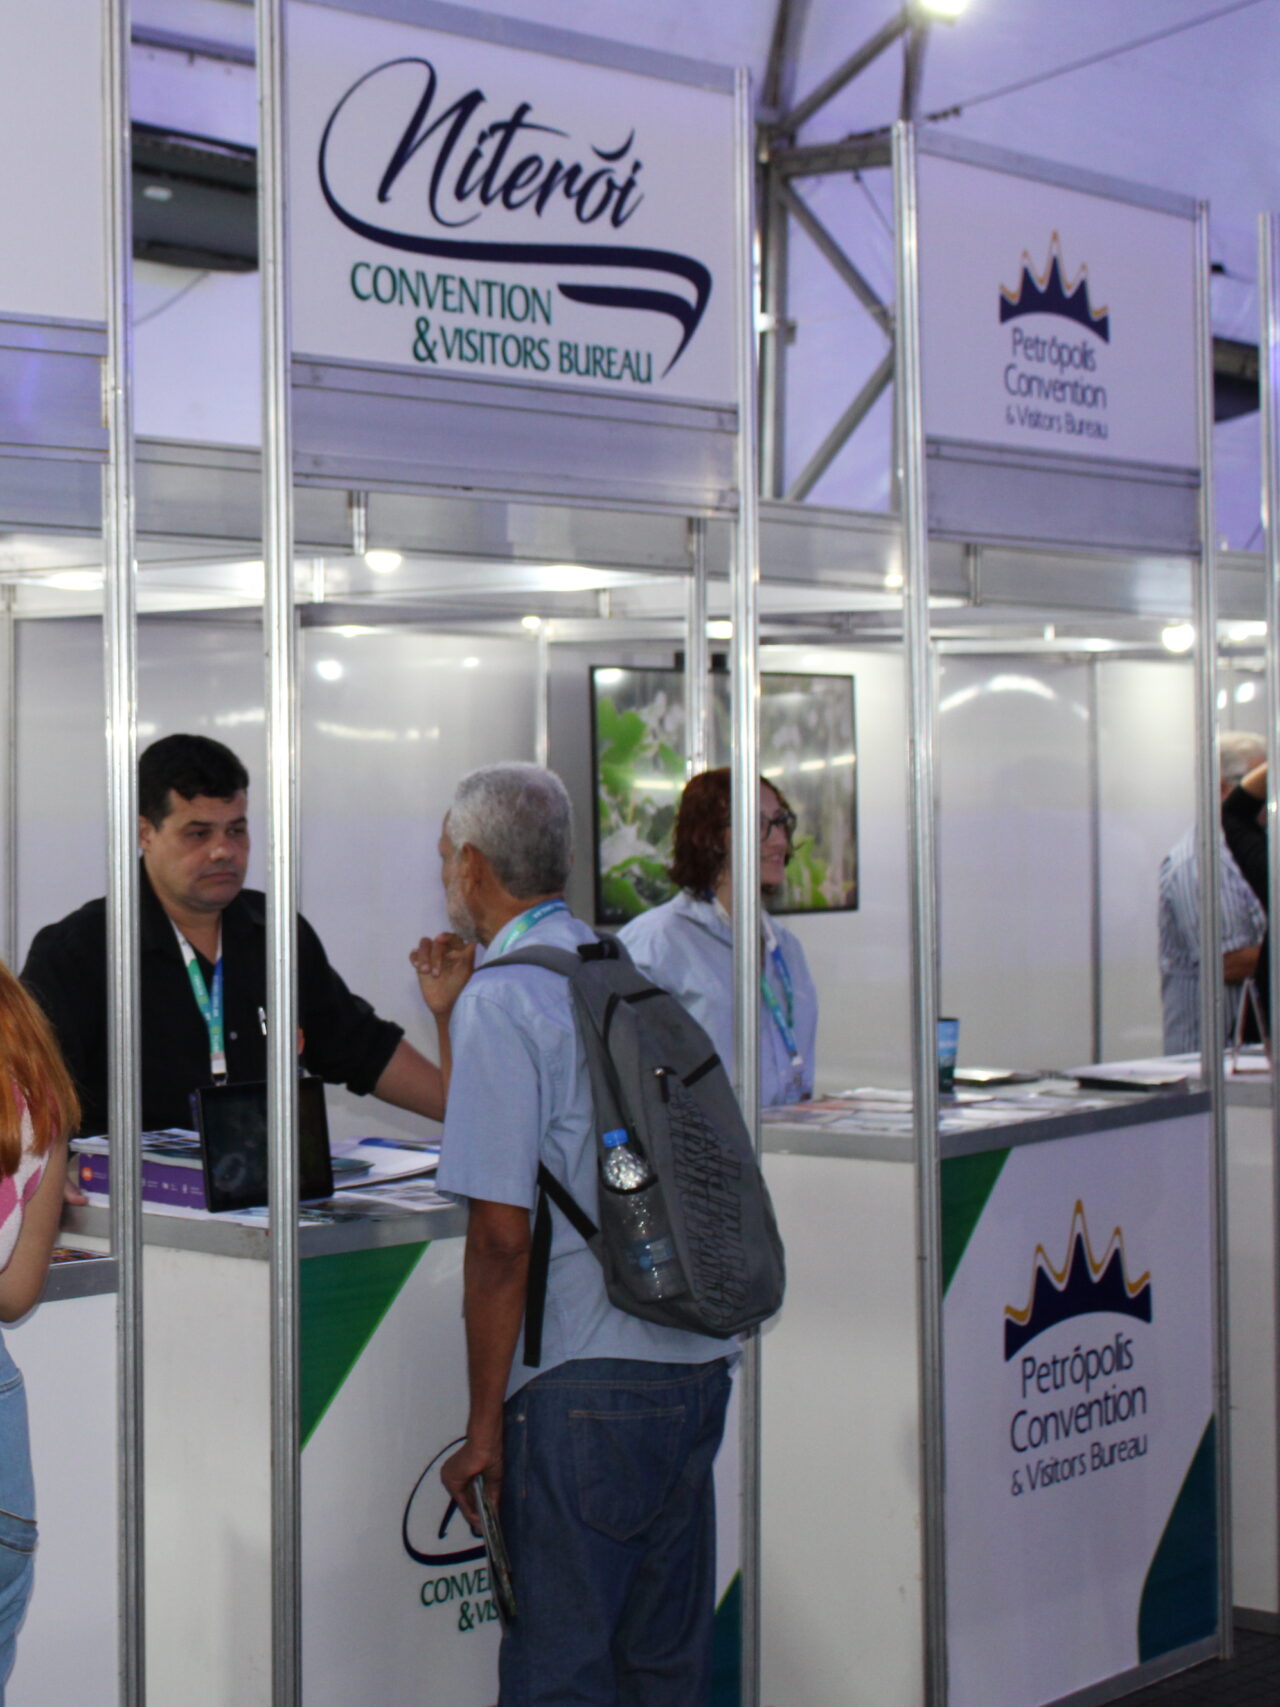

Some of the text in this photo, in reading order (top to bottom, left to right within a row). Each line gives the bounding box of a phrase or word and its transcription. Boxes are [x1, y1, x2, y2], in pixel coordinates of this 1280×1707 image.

[350, 261, 553, 326] CONVENTION
[558, 340, 653, 384] BUREAU
[1012, 326, 1097, 374] Petrópolis
[1004, 363, 1107, 409] Convention
[1016, 404, 1063, 433] Visitors
[1065, 411, 1109, 440] Bureau
[1022, 1332, 1134, 1398] Petrópolis
[1011, 1384, 1147, 1452] Convention
[1012, 1434, 1148, 1496] & Visitors Bureau
[421, 1567, 492, 1607] CONVE
